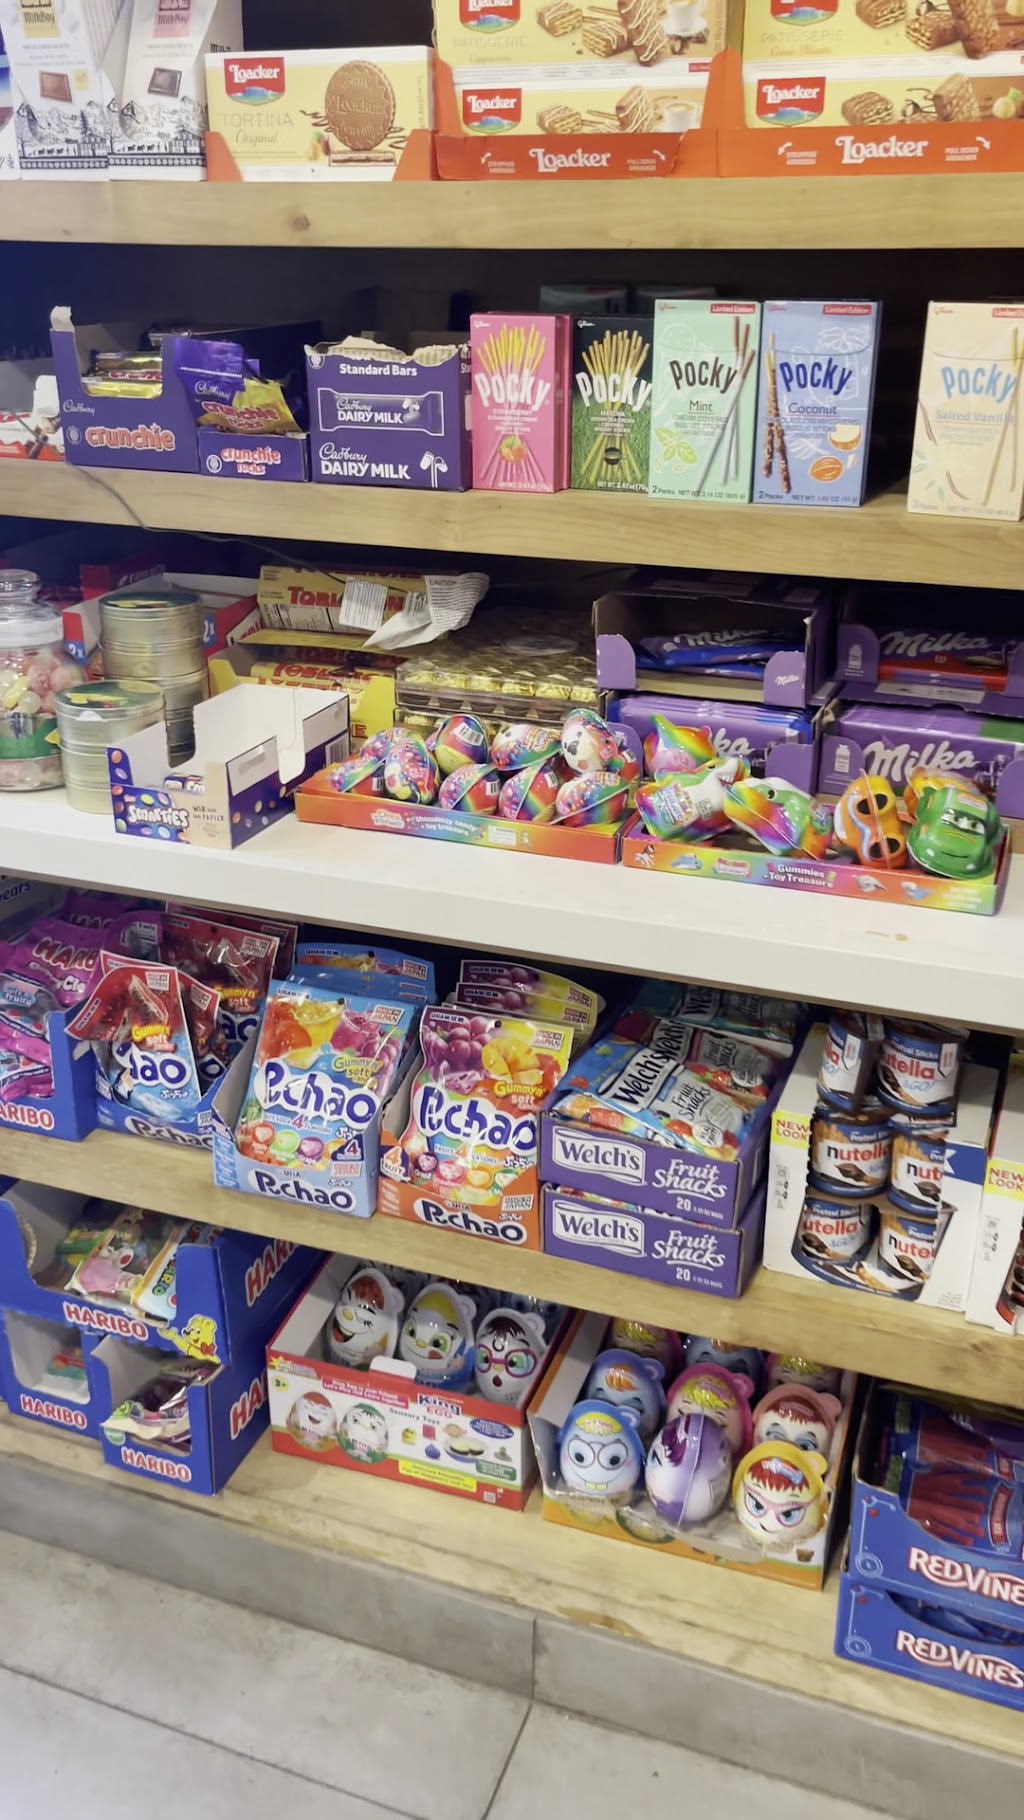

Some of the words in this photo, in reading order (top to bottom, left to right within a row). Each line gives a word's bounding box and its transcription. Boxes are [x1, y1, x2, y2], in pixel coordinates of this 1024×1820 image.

[761, 30, 843, 44] PATISSERIE
[229, 65, 281, 84] Loacker
[762, 85, 820, 104] Loacker
[467, 96, 517, 114] Loacker
[222, 113, 294, 128] TORTINA
[235, 131, 278, 148] Original
[835, 136, 929, 164] Loacker
[529, 148, 611, 173] Loacker
[339, 363, 390, 376] Standard
[392, 366, 417, 376] Bars
[194, 380, 231, 401] Cadbury
[63, 399, 95, 415] Cadbury
[201, 401, 279, 421] crunchie
[336, 397, 372, 412] Cadbury
[689, 400, 713, 411] Mint
[788, 403, 838, 414] Coconut
[338, 411, 372, 423] DAIRY
[374, 413, 403, 424] MILK
[936, 410, 970, 421] Salted
[85, 424, 175, 451] crunchie
[221, 447, 281, 465] crunchie
[319, 442, 367, 463] Cadbury
[237, 462, 265, 475] rocks
[321, 461, 369, 477] DAIRY
[371, 464, 411, 480] MILK
[429, 579, 457, 587] CAUTION
[879, 631, 991, 657] Milka
[774, 675, 800, 686] Milka
[863, 741, 980, 782] Milka
[769, 872, 788, 883] Toy
[787, 873, 834, 888] Treasure
[778, 865, 825, 878] Gummies
[0, 881, 32, 900] ears
[404, 967, 427, 979] JAPAN
[372, 1011, 398, 1023] JAPAN
[391, 1008, 400, 1016] IN
[915, 1048, 939, 1060] Sticks
[348, 1067, 370, 1077] soft
[882, 1053, 936, 1080] utella
[612, 1049, 671, 1106] Welch's
[511, 1094, 535, 1105] soft
[671, 1082, 696, 1108] Fruit
[679, 1085, 712, 1120] Snacks
[0, 1101, 54, 1128] ARIBO
[292, 1114, 305, 1129] 4
[776, 1118, 808, 1133] NEW
[776, 1128, 808, 1142] LOOK
[347, 1140, 359, 1155] 4
[385, 1146, 402, 1165] 4
[456, 1142, 468, 1157] 4
[558, 1139, 640, 1171] Welch's
[669, 1158, 720, 1180] Fruit
[989, 1167, 1024, 1182] NEW
[652, 1169, 727, 1198] Snacks
[988, 1177, 1024, 1191] LOOK
[676, 1197, 692, 1211] 20
[812, 1207, 839, 1217] Pretzel
[558, 1213, 640, 1242] Welch's
[803, 1219, 858, 1236] utella
[667, 1230, 718, 1250] Fruit
[651, 1240, 726, 1267] Snacks
[675, 1268, 691, 1282] 20
[64, 1302, 148, 1340] HARIBO
[20, 1395, 87, 1429] HARIBO
[418, 1394, 460, 1415] King
[426, 1406, 453, 1419] EGG
[389, 1408, 420, 1421] Sensory
[422, 1415, 440, 1425] Toys
[121, 1447, 192, 1482] HARIBO
[908, 1547, 964, 1581] RED
[963, 1563, 1024, 1607] VINE
[897, 1630, 949, 1661] RED
